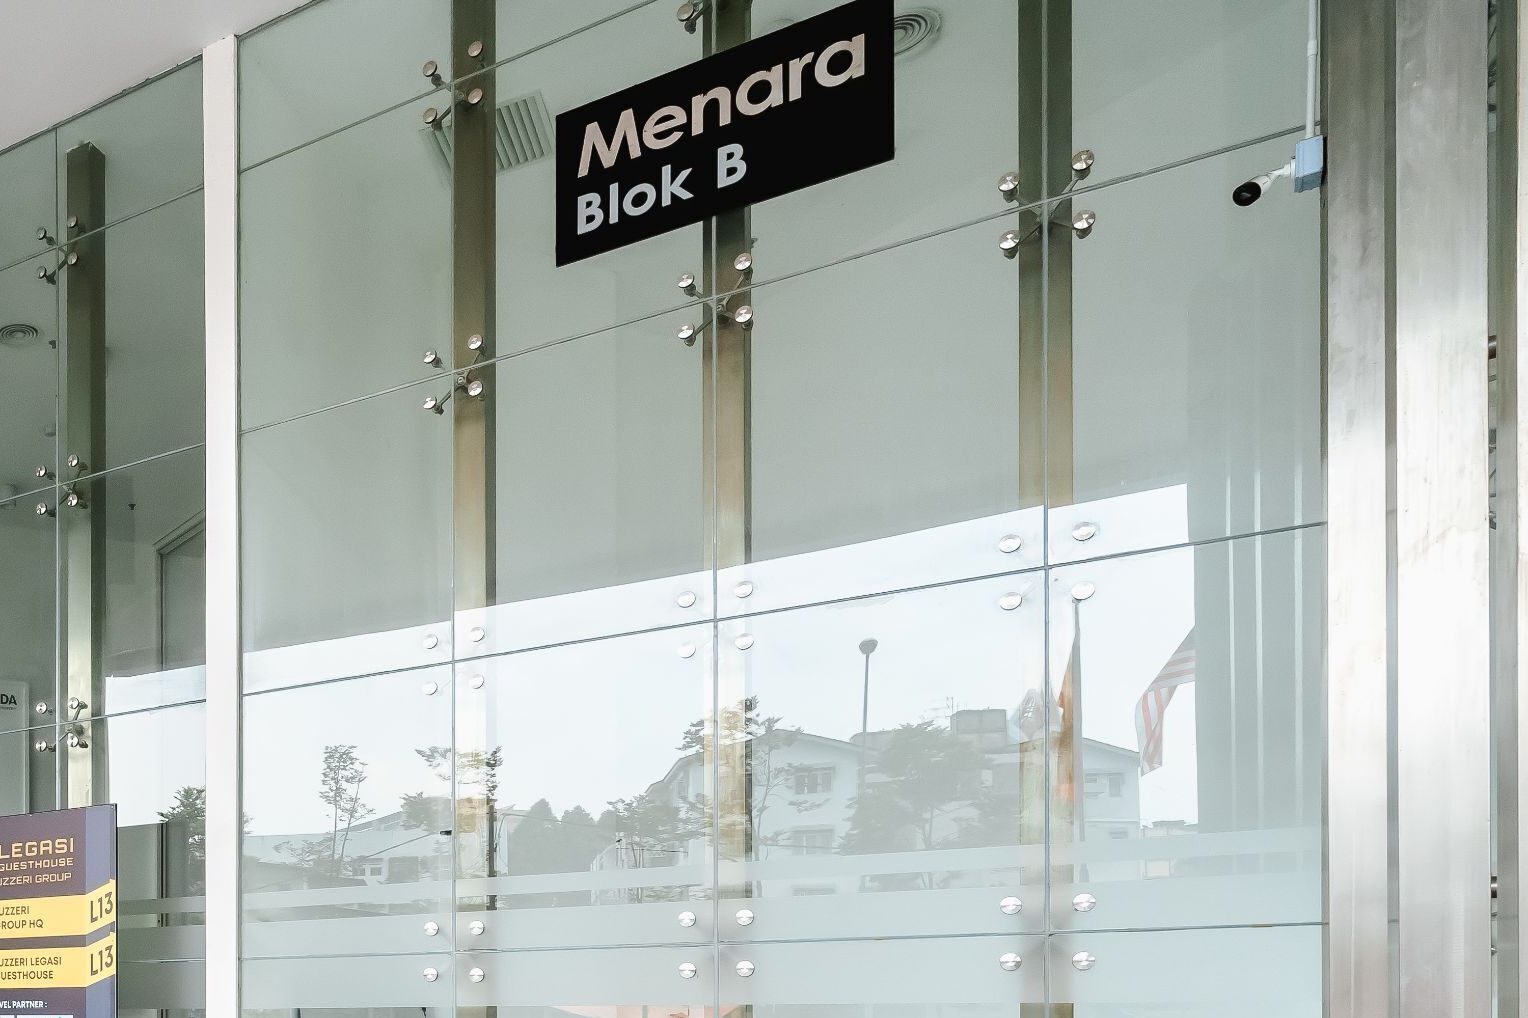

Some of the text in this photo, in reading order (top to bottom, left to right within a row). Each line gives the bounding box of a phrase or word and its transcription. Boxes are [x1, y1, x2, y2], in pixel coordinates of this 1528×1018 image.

[577, 33, 865, 178] Menara
[577, 143, 747, 236] Blok B
[35, 872, 72, 884] GROUP
[90, 891, 114, 923] L13
[29, 919, 44, 929] HQ
[30, 956, 62, 966] LEGASI
[90, 944, 114, 977] L13
[12, 1000, 44, 1009] PARTNER
